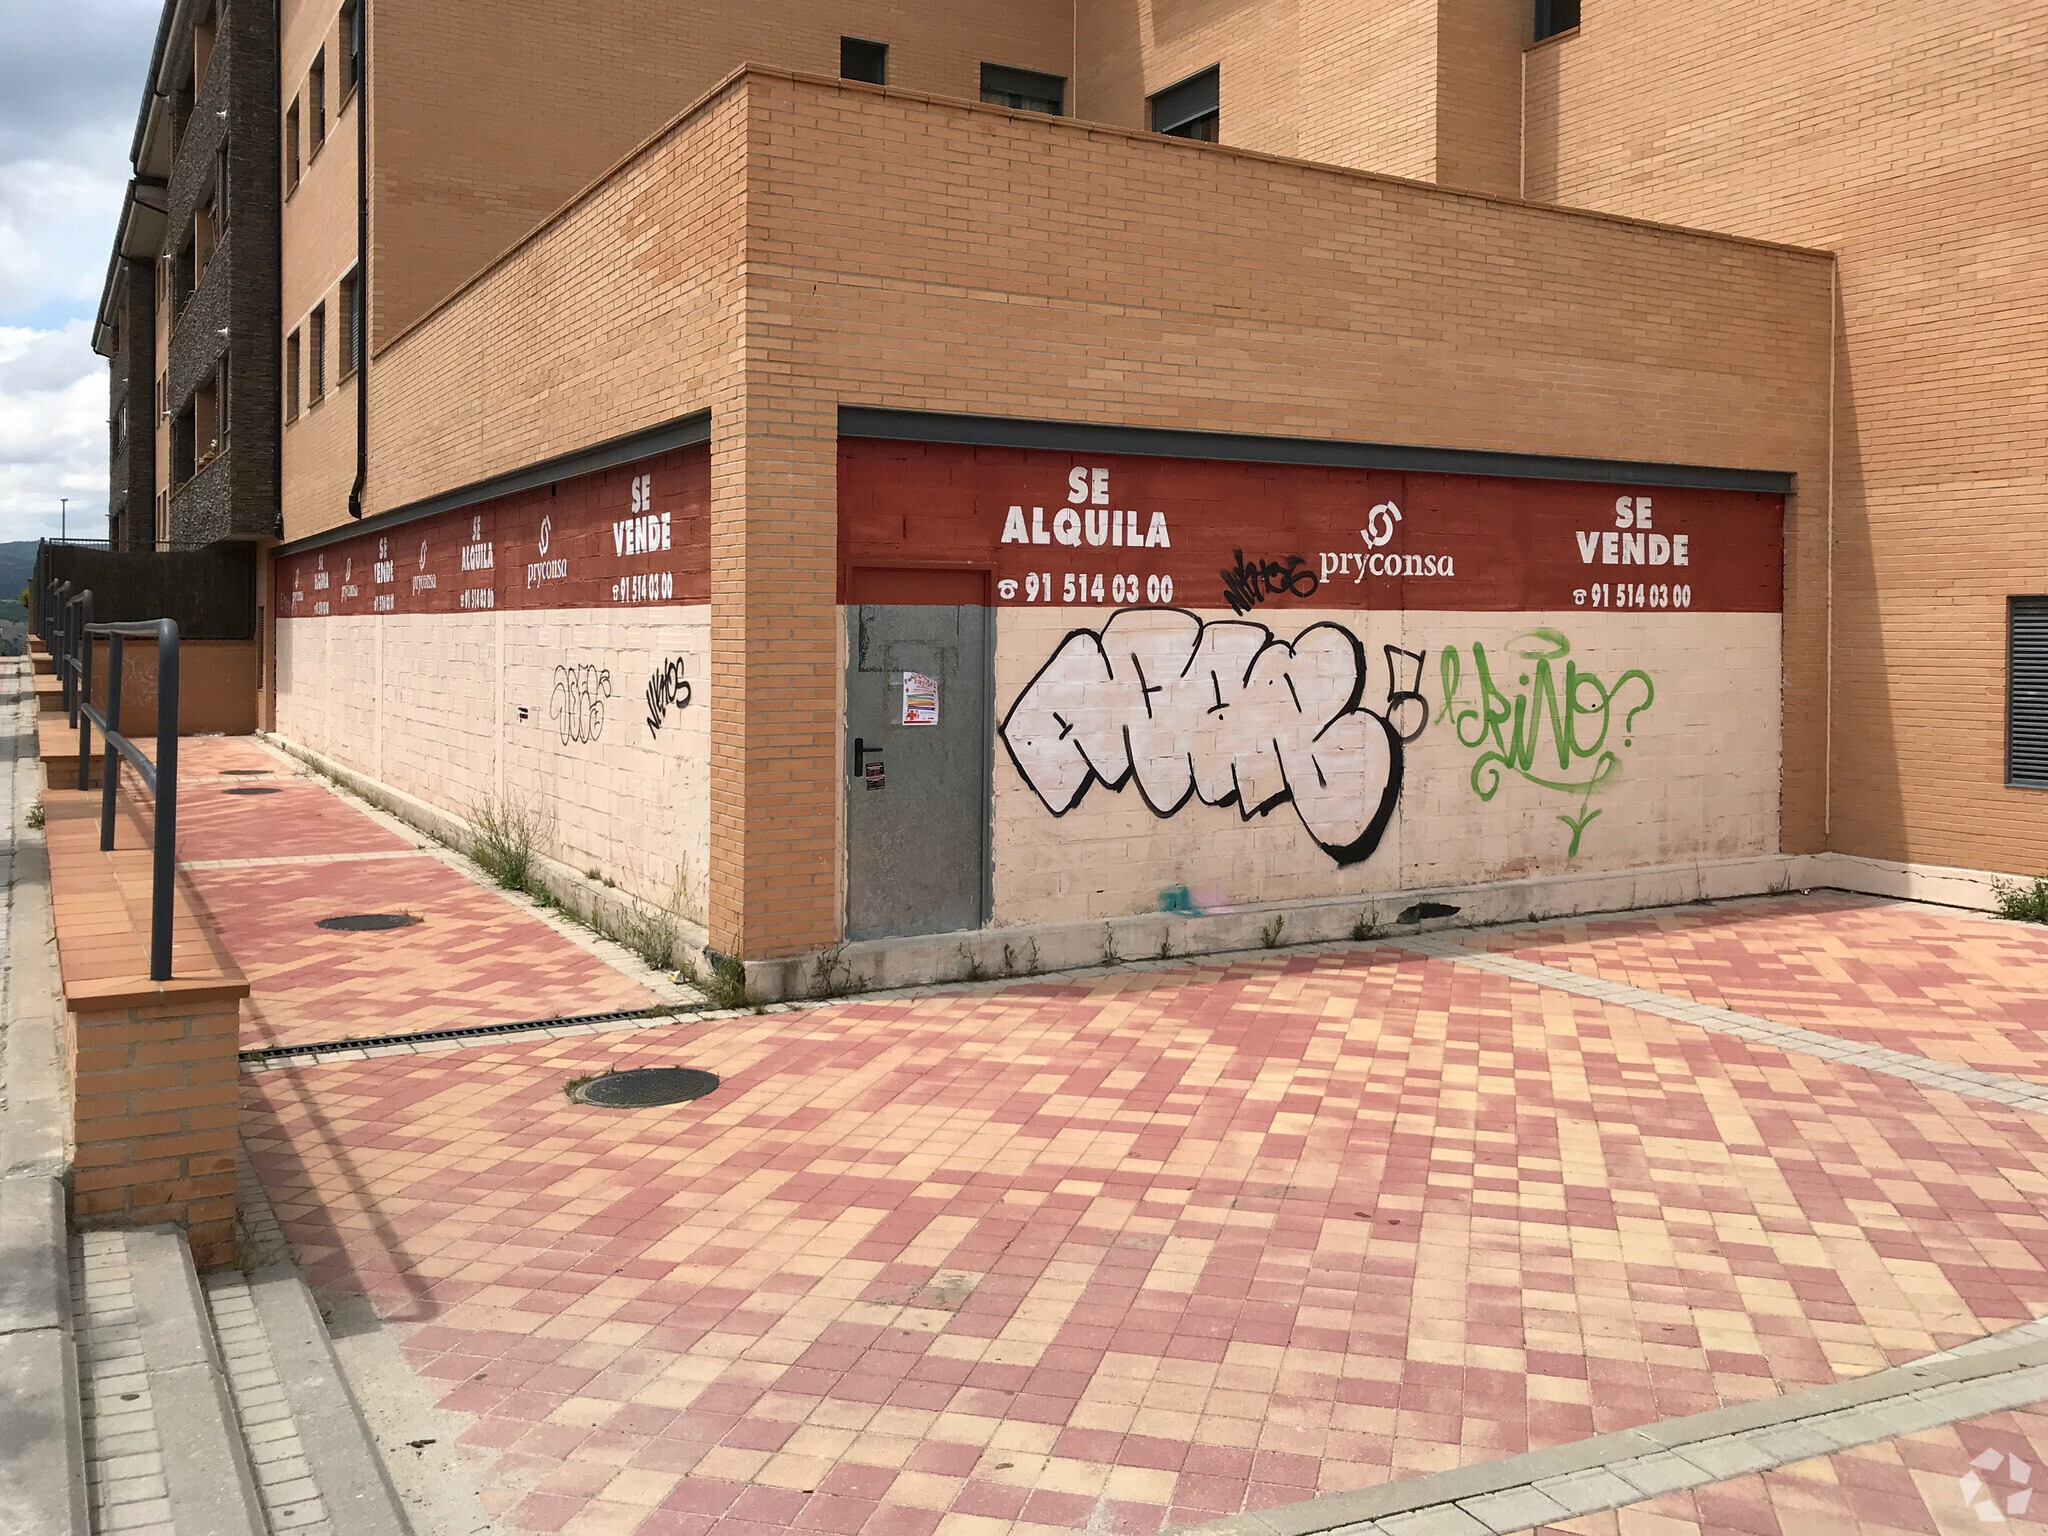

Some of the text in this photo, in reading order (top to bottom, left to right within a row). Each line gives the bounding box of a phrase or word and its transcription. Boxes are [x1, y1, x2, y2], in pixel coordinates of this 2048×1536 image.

[631, 473, 651, 513] SE
[1068, 466, 1109, 505] SE
[472, 515, 481, 541] SE
[1001, 506, 1170, 548] ALQUILA
[1615, 496, 1653, 529] SE
[613, 512, 671, 557] VENDE
[1575, 531, 1689, 566] VENDE
[461, 542, 494, 571] ALQUILA
[527, 557, 568, 589] pryconsa
[1319, 549, 1455, 584] pryconsa
[621, 571, 673, 602] 91 514 03 00
[1025, 572, 1174, 604] 91 514 03 00
[1591, 583, 1691, 608] 91 514 03 00
